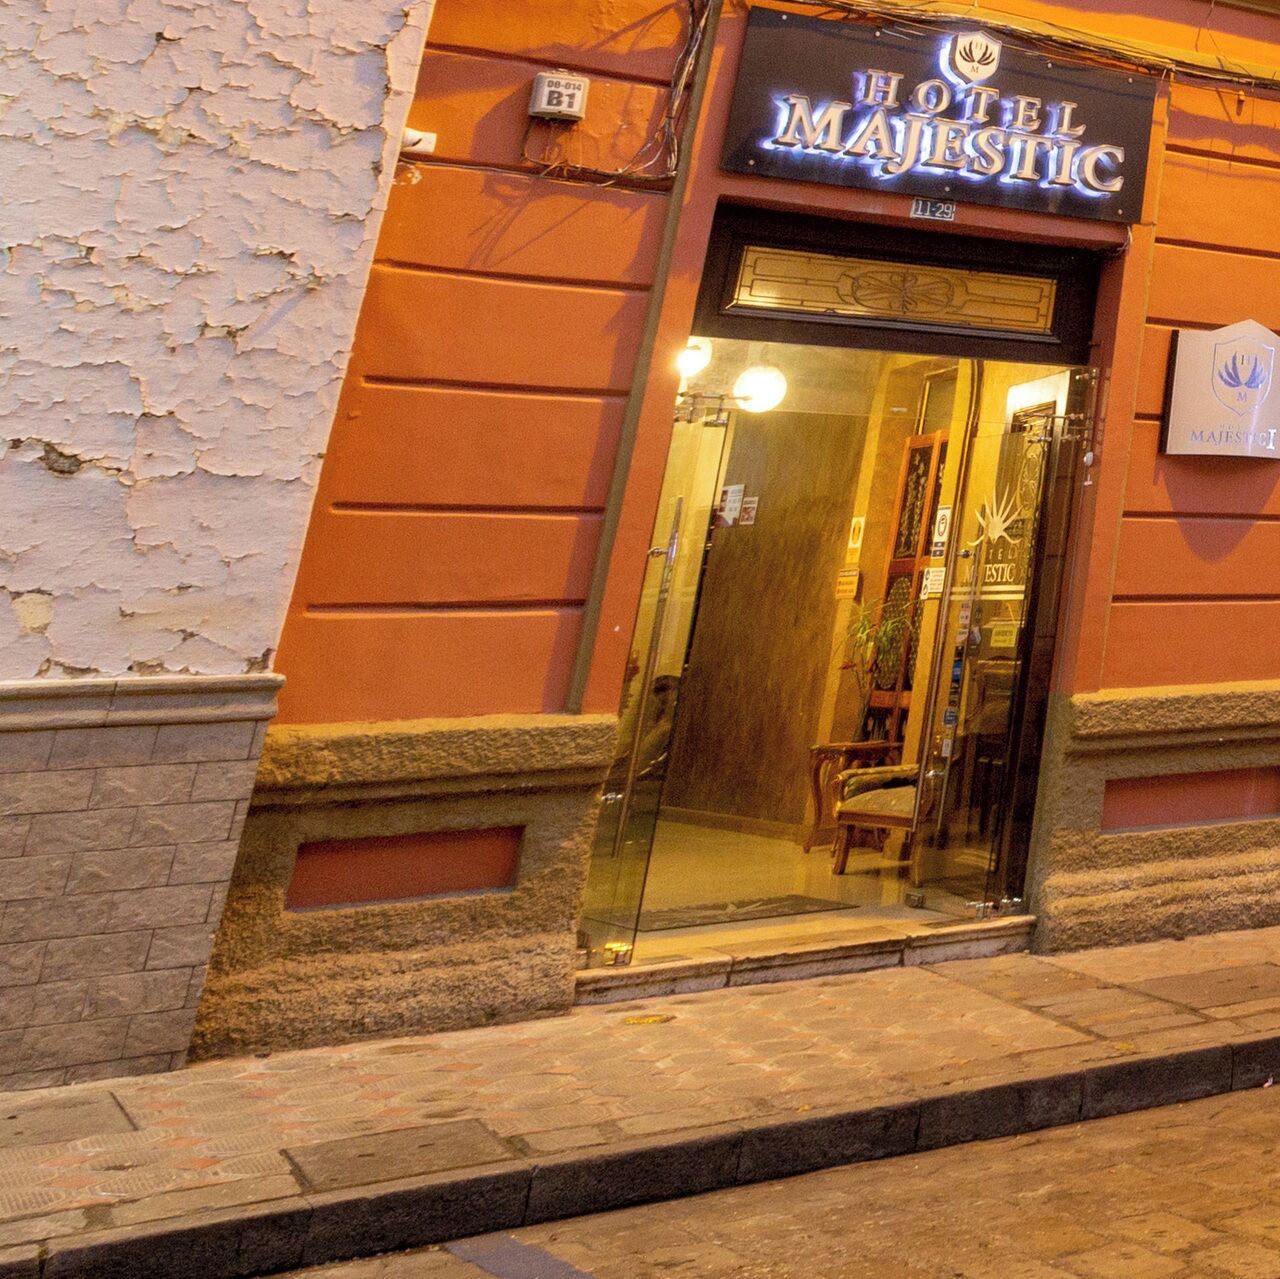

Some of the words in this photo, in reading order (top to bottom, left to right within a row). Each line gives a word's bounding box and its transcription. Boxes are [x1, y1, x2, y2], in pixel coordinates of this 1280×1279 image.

[546, 89, 576, 109] B1
[864, 69, 1087, 137] HOTEL
[775, 93, 1126, 193] MAJESTIC
[915, 200, 953, 218] 11-29
